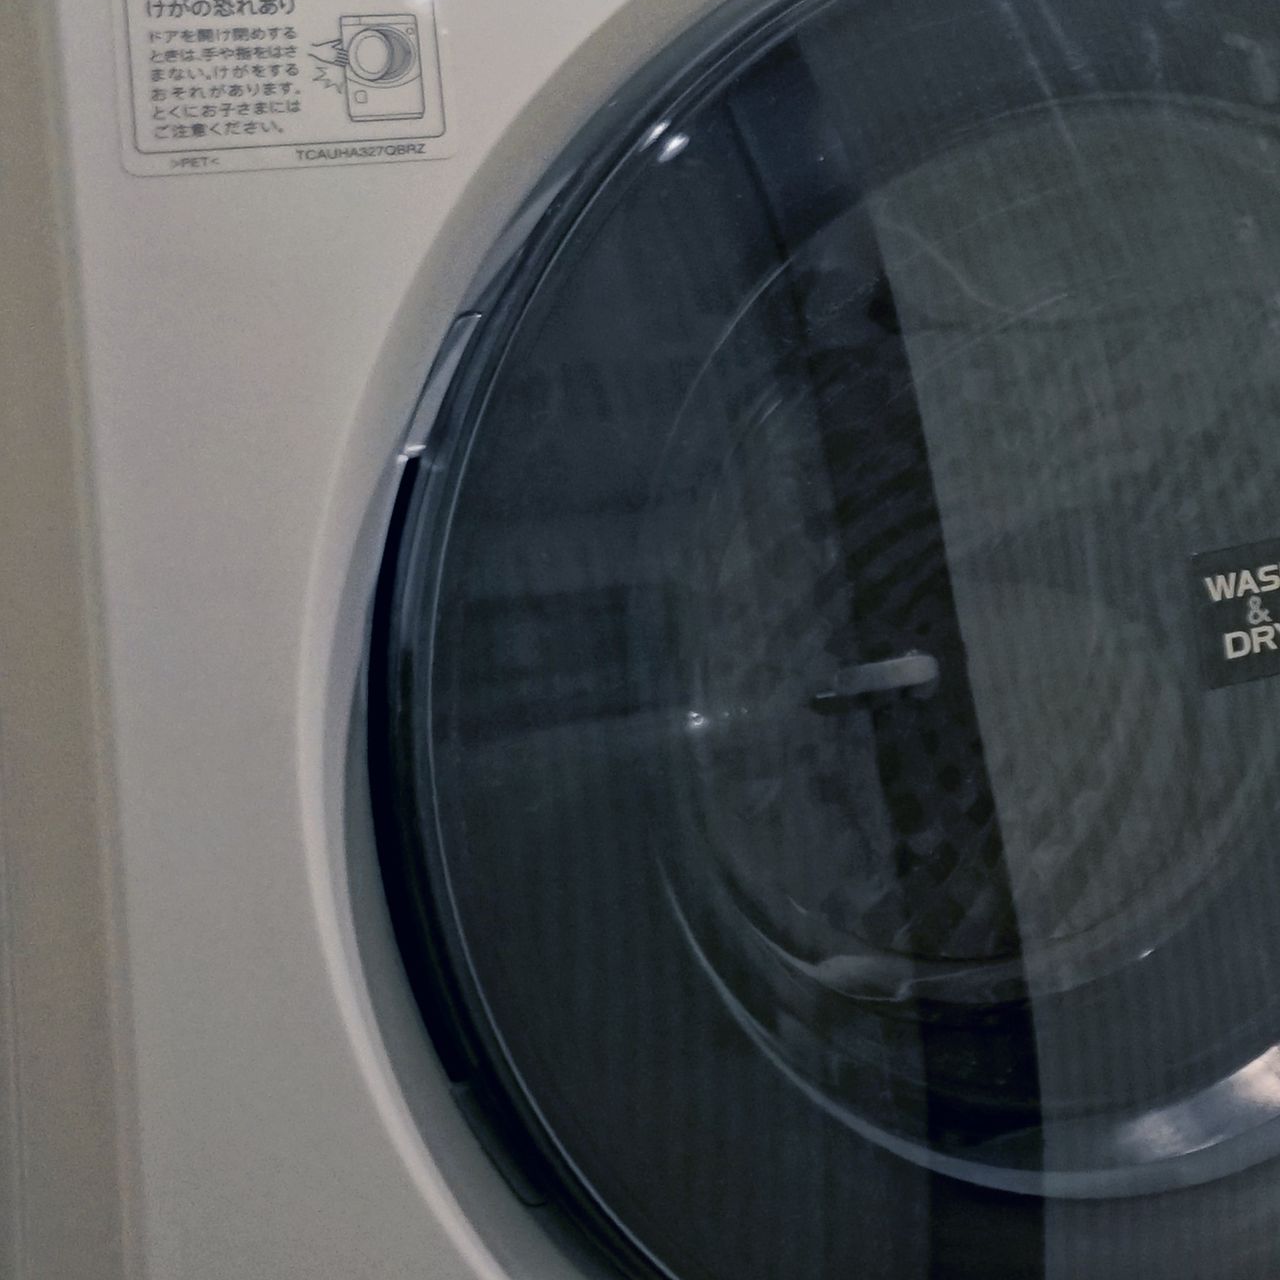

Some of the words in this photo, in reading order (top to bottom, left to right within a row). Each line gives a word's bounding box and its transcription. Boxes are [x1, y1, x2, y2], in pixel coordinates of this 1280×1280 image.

[149, 26, 298, 44] ドアを開け閉めする
[152, 81, 300, 102] おそれがあります。
[153, 100, 302, 120] とくにお子さまには
[154, 121, 285, 139] ご注意ください。
[1247, 595, 1273, 625] &
